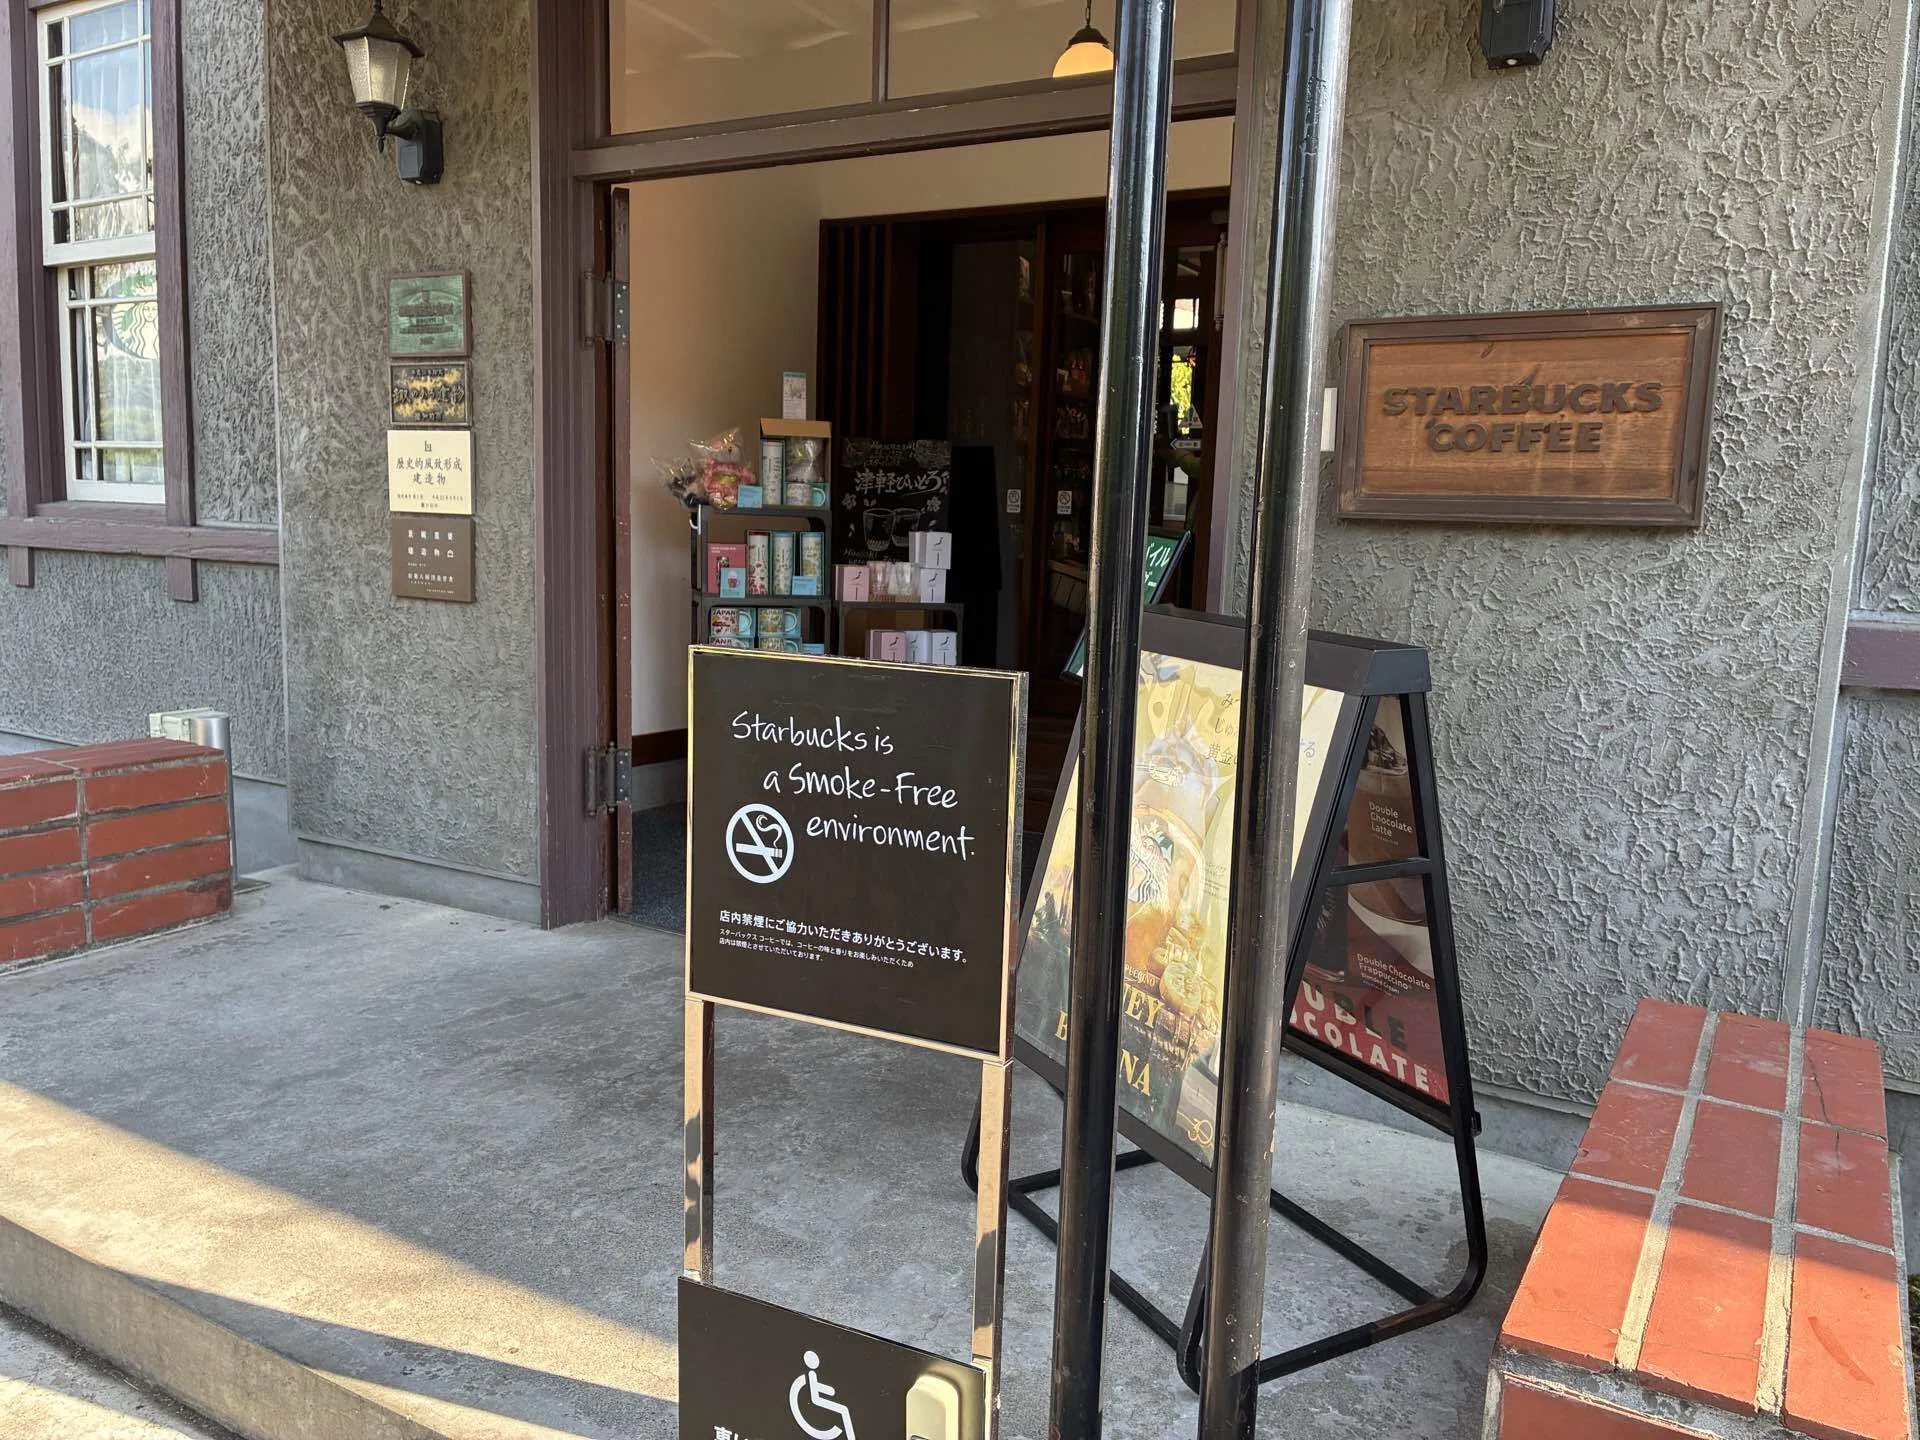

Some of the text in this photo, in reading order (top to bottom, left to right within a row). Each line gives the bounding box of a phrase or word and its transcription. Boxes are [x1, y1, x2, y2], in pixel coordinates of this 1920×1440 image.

[1382, 381, 1664, 416] STARBUCKS
[1430, 420, 1603, 454] COFFEE
[732, 711, 894, 755] Starbucks is
[763, 762, 958, 809] a Smoke-Free
[1369, 801, 1399, 818] Double
[1370, 812, 1413, 833] Chocolate
[806, 815, 976, 861] environment.
[1371, 822, 1393, 837] Latte
[718, 937, 824, 962] 店内は禁煙とさせていただいております。
[719, 910, 968, 964] 店内禁煙にご協力いただきありがとうございます。
[1357, 953, 1387, 970] Double
[1389, 964, 1431, 990] Chocolate
[1302, 980, 1409, 1051] UBLE
